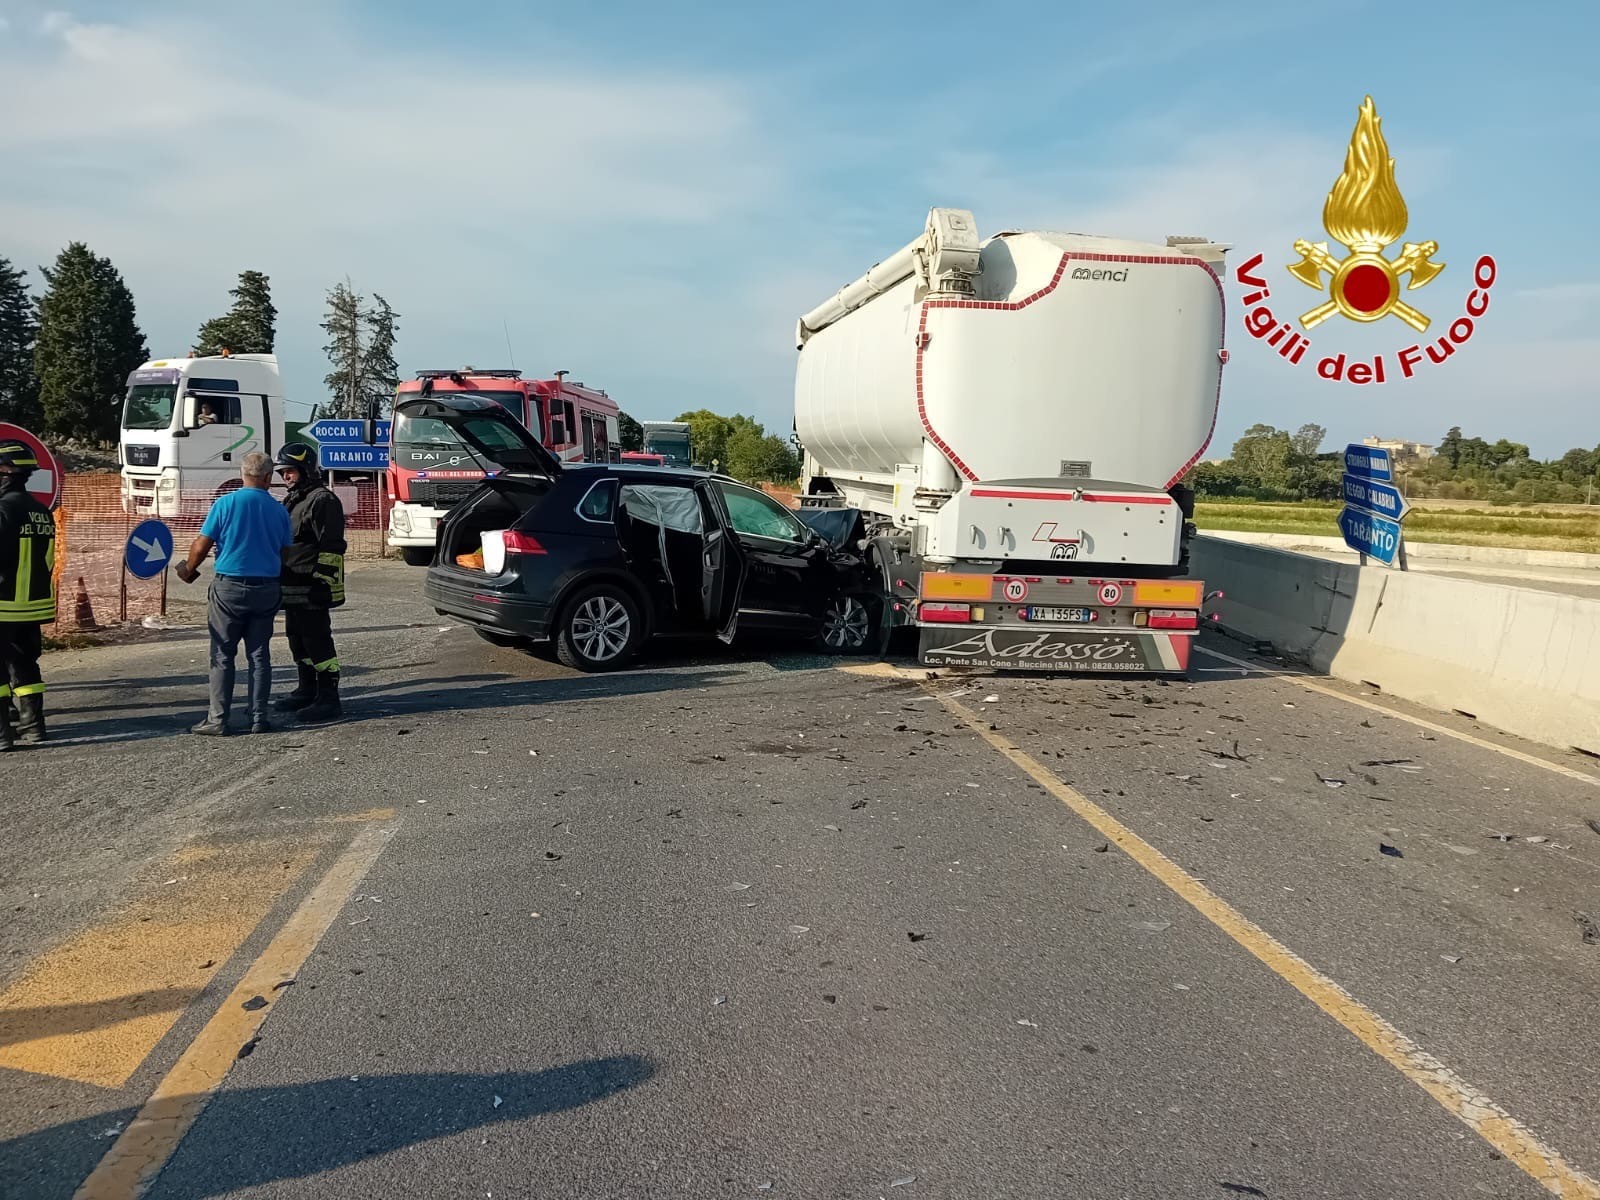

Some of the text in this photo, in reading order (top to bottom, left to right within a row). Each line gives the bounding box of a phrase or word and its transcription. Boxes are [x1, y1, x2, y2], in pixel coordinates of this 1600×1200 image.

[315, 426, 346, 437] ROCCA
[349, 427, 359, 437] DI
[328, 451, 373, 462] TARANTO
[1346, 481, 1396, 511] REGGIO CALABRIA
[1347, 519, 1394, 551] TARANTO
[1010, 585, 1021, 595] 70
[1104, 588, 1116, 599] 80
[1033, 608, 1046, 619] XA
[926, 629, 1129, 660] Adesso
[924, 655, 943, 664] Loc.
[945, 656, 970, 665] Ponte
[971, 658, 988, 666] San
[1018, 660, 1053, 669] Buccino
[1054, 661, 1073, 670] (SA)
[1074, 661, 1090, 670] Tel.
